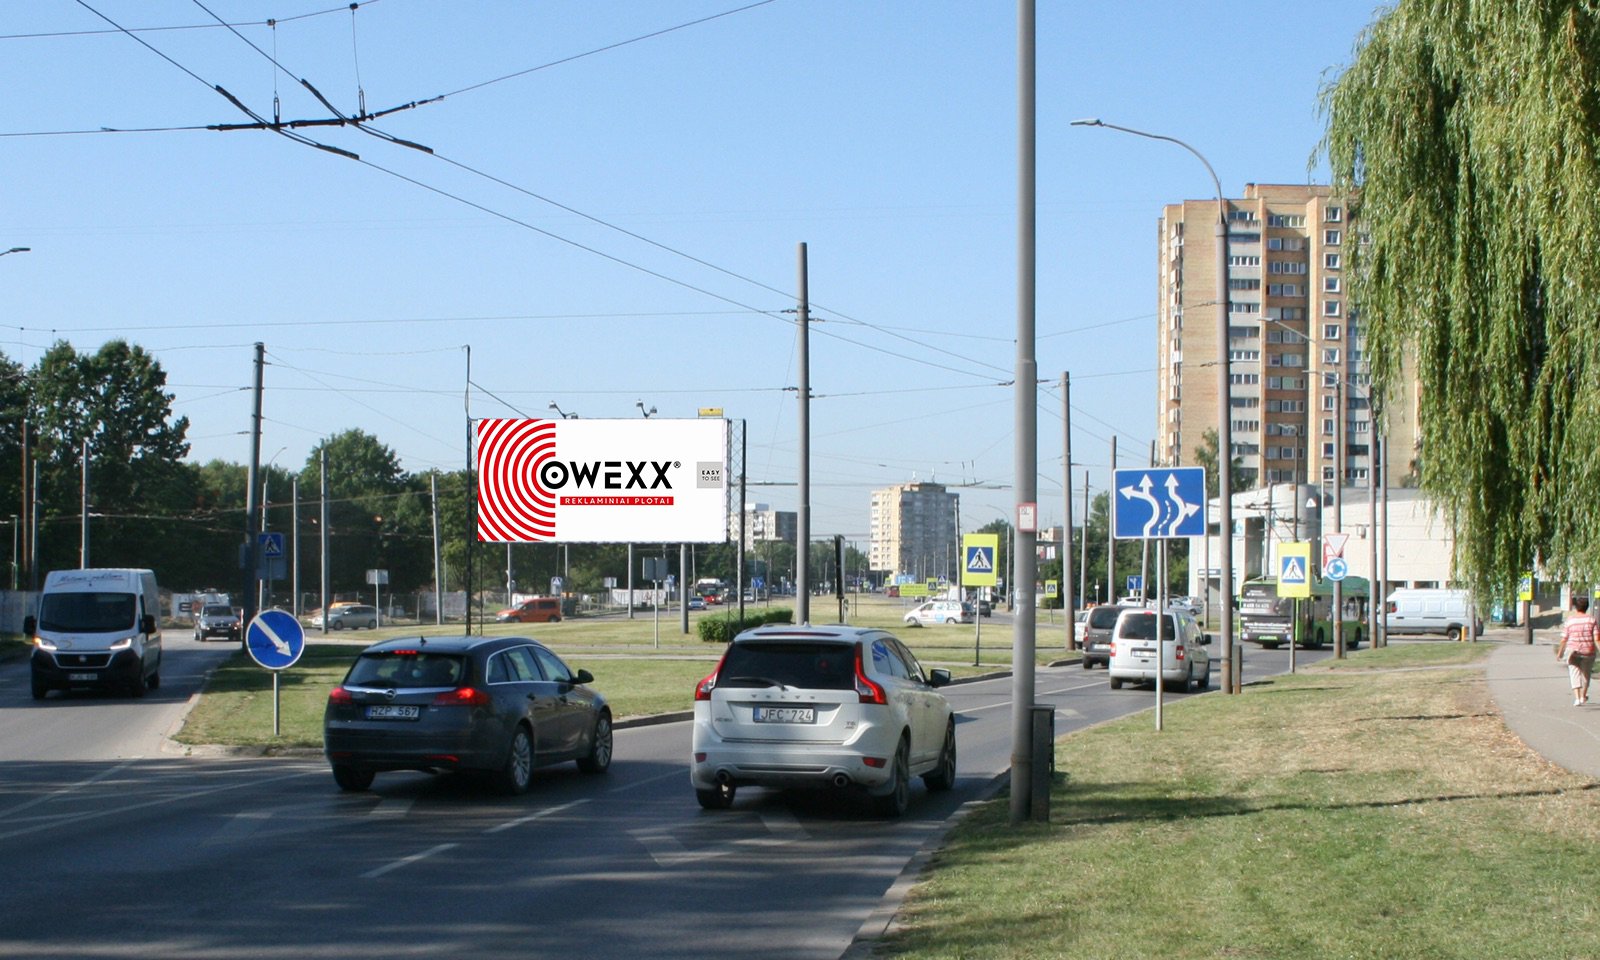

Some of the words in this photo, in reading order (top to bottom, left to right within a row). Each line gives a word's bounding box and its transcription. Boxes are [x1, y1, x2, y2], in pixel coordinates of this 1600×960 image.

[371, 706, 392, 716] HZP
[398, 706, 417, 716] 567
[761, 709, 784, 721] JFC
[791, 709, 812, 721] 724
